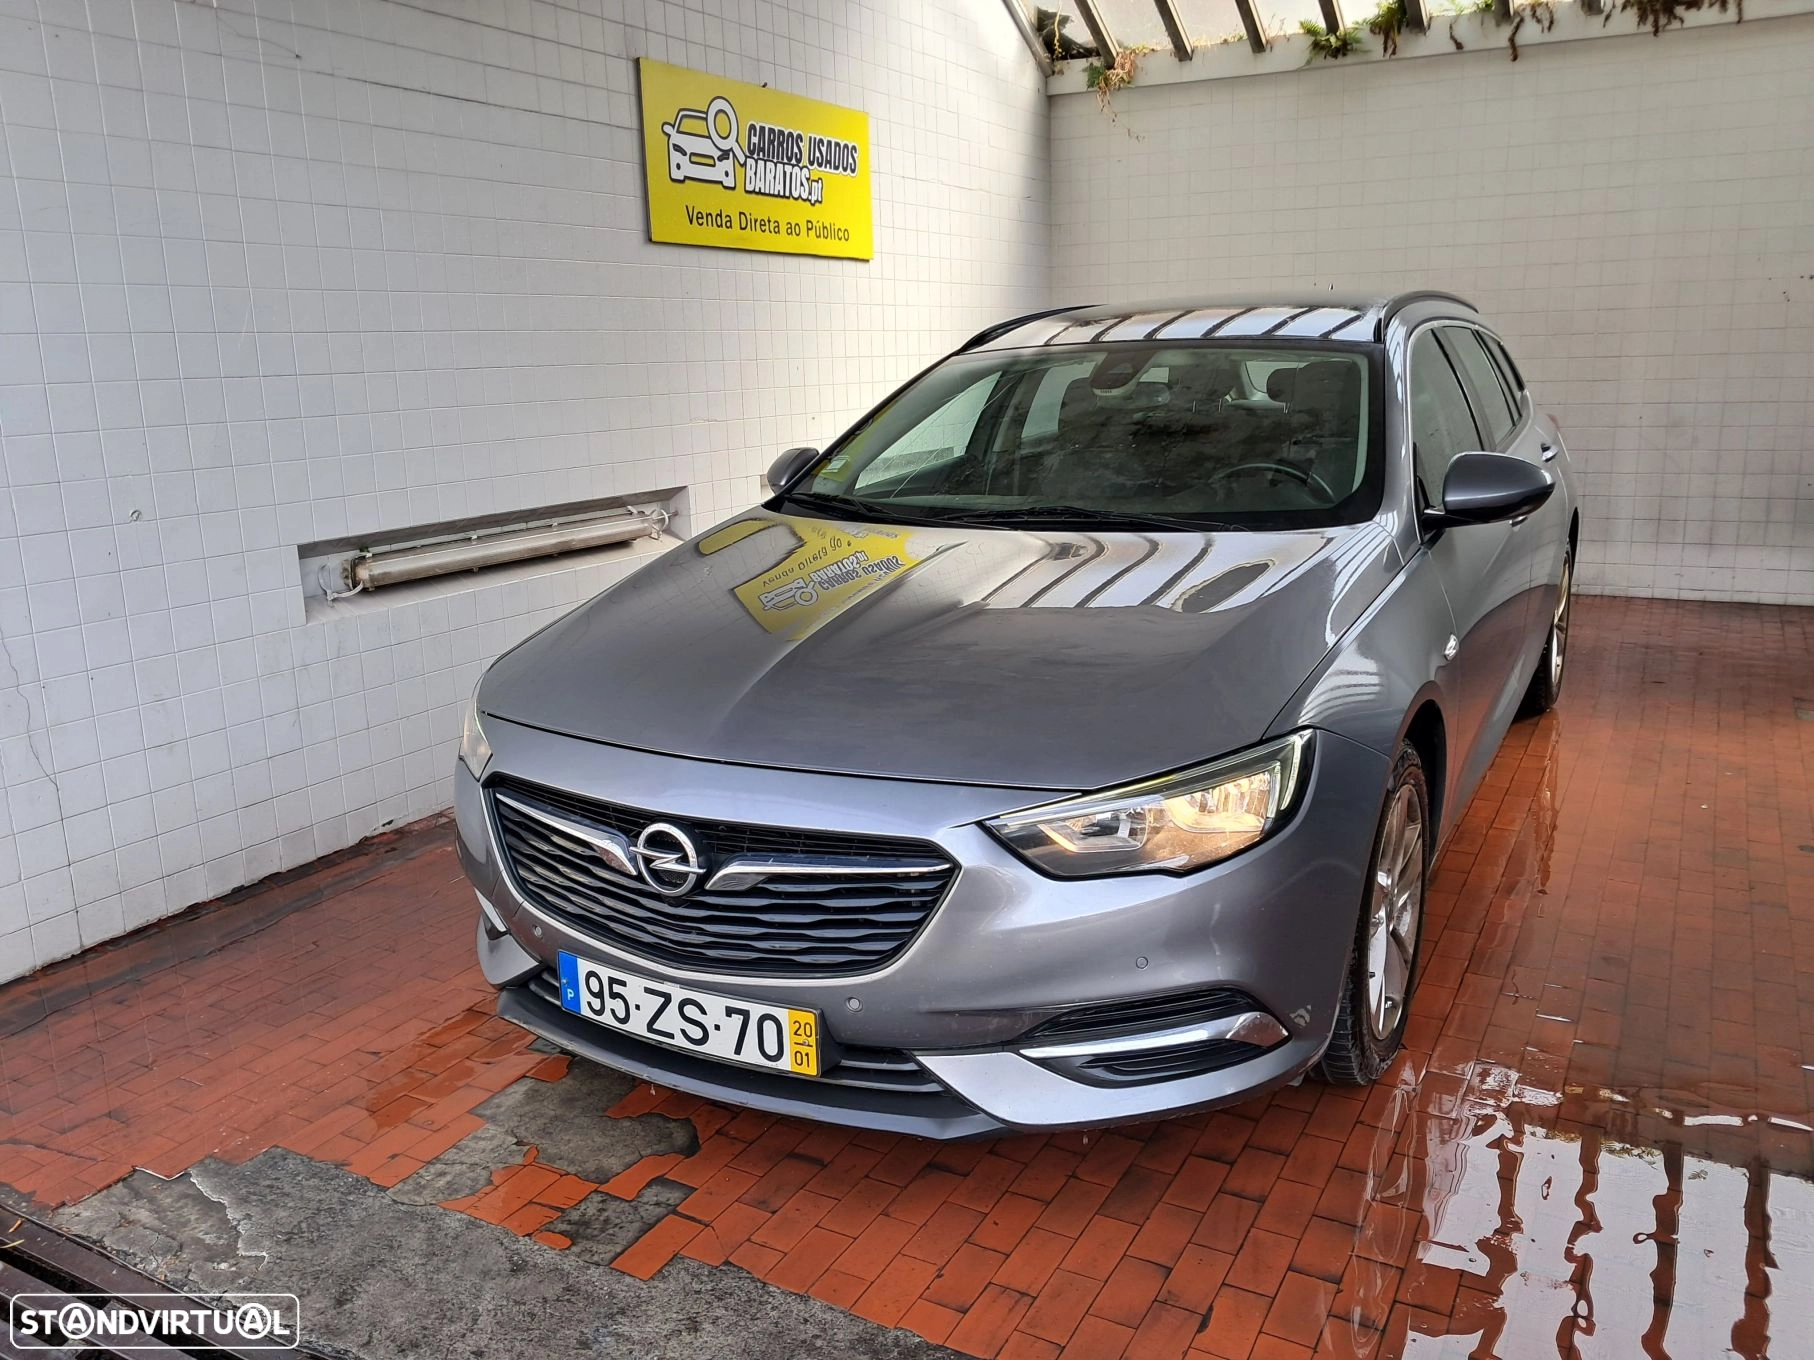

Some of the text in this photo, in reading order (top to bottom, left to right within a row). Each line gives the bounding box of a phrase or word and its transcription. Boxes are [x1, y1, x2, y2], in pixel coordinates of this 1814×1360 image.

[747, 122, 858, 175] CARROS USADOS
[745, 156, 823, 205] BARATOS.pt
[685, 205, 850, 242] Venda Direta ao Público
[567, 988, 575, 1000] P
[792, 1020, 813, 1038] 20
[794, 1050, 811, 1068] 01
